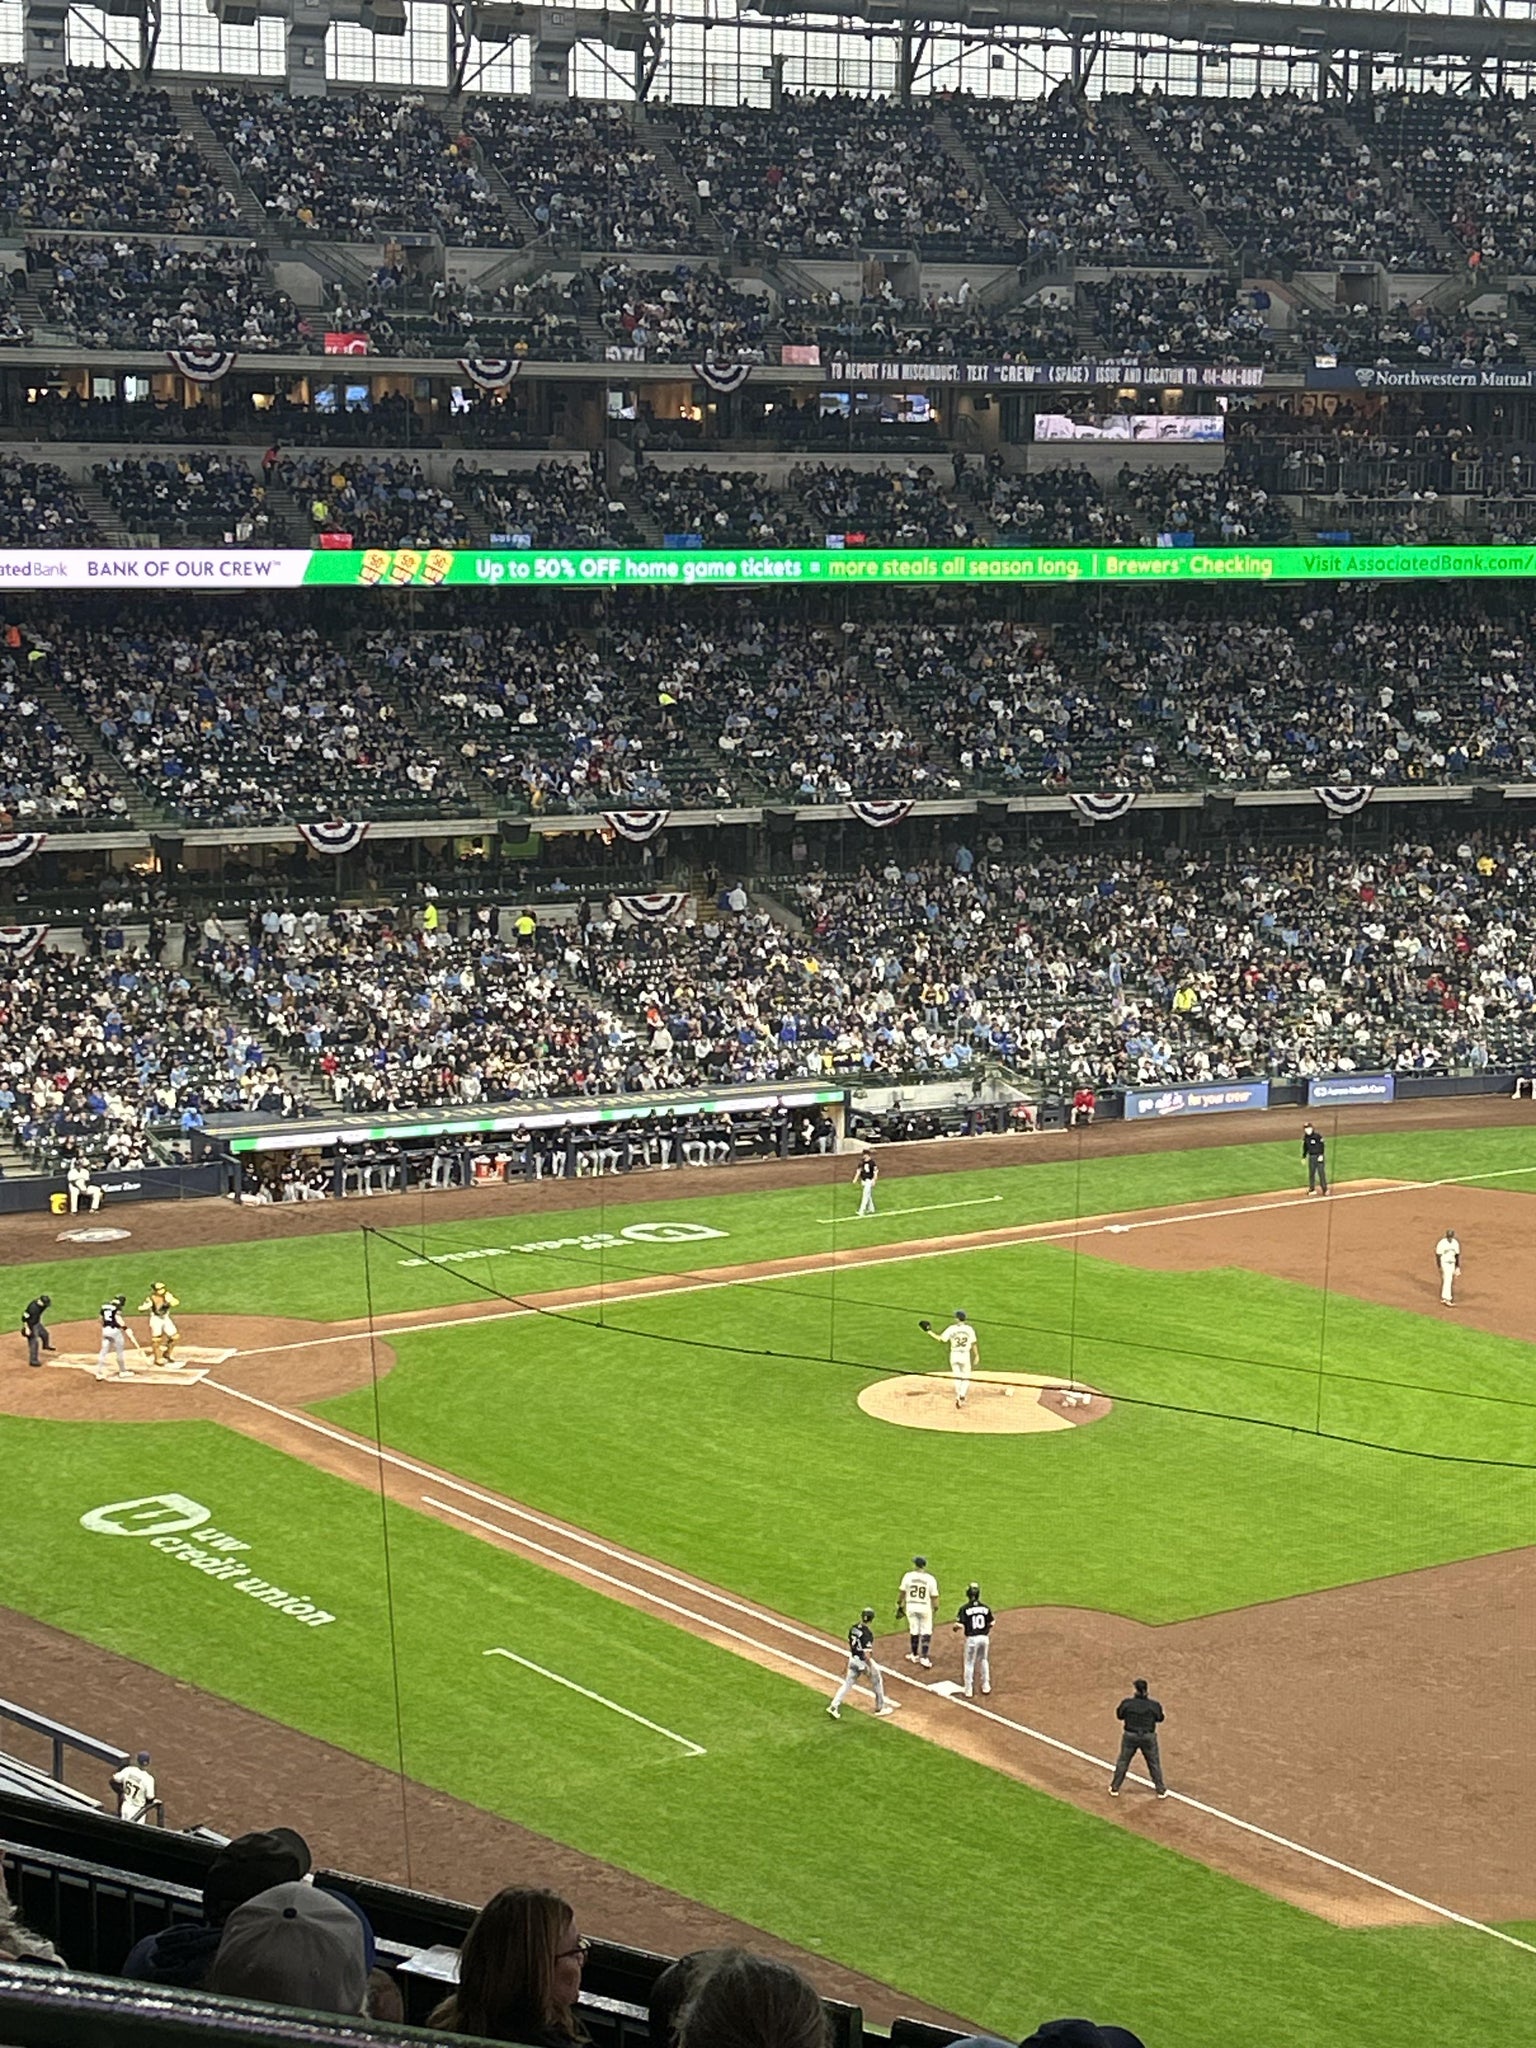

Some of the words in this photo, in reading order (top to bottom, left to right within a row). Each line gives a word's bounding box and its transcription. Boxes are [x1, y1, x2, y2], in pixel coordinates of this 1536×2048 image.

[831, 363, 842, 380] TO
[845, 363, 878, 380] REPORT
[881, 364, 899, 380] FAN
[967, 365, 989, 381] TEXT
[1096, 367, 1120, 383] ISSUE
[1124, 367, 1141, 383] AND
[1144, 367, 1184, 384] LOCATION
[1187, 368, 1197, 384] TO
[1375, 370, 1477, 386] Northwestern
[1480, 371, 1533, 387] Mutual
[87, 561, 139, 576] BANK
[144, 561, 169, 577] OF
[175, 561, 214, 577] OUR
[475, 558, 504, 584] Up
[508, 560, 530, 578] to
[534, 558, 576, 578] 50%
[579, 558, 621, 578] OFF
[625, 557, 678, 577] home
[683, 560, 736, 584] game
[740, 557, 802, 577] tickets
[828, 561, 878, 576] more
[882, 556, 938, 576] steals
[942, 556, 965, 576] all
[969, 559, 1034, 576] season
[1190, 556, 1273, 580] Checking
[1303, 555, 1341, 572] Visit
[1347, 554, 1536, 572] AssociatedBank.com/
[954, 1337, 968, 1348] 32
[190, 1527, 252, 1552] uw
[150, 1536, 252, 1580] credit
[233, 1577, 336, 1627] union
[910, 1585, 927, 1600] 28
[971, 1614, 986, 1630] 10
